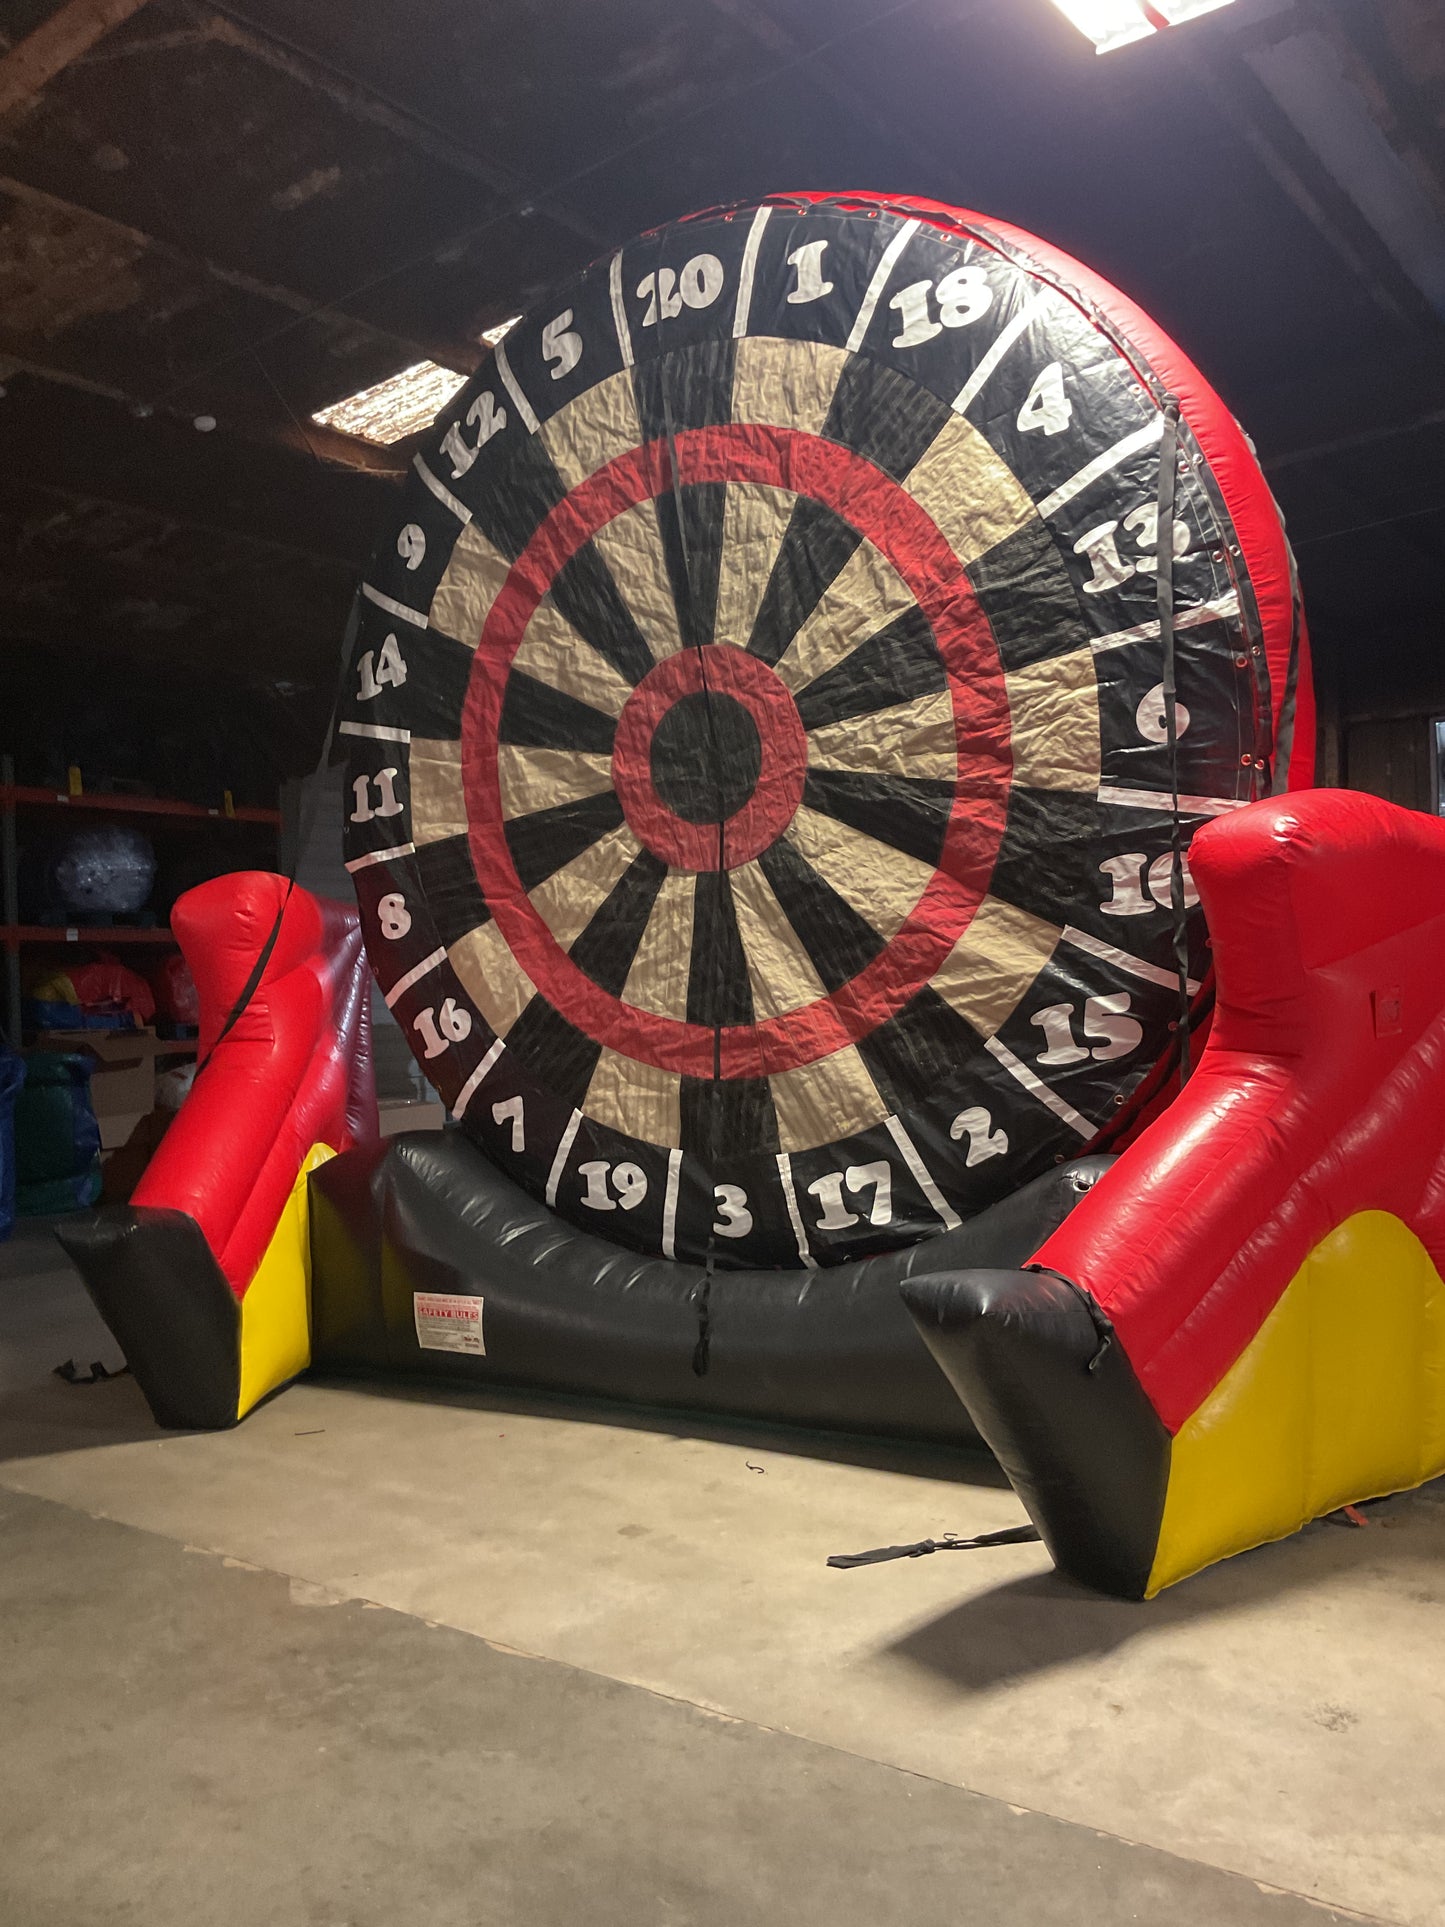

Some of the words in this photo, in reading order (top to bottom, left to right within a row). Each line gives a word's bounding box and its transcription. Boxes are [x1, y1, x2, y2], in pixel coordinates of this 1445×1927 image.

[636, 253, 724, 327] 20
[787, 239, 834, 304] 1
[889, 265, 994, 349] 18
[542, 308, 583, 380] 5
[1016, 361, 1073, 436] 4
[439, 391, 507, 480] 12
[397, 523, 427, 571] 9
[356, 633, 408, 700] 14
[350, 767, 404, 823] 11
[377, 892, 412, 940] 8
[413, 997, 472, 1059] 16
[1030, 991, 1143, 1065] 15
[491, 1095, 525, 1153] 7
[949, 1106, 1009, 1168] 2
[578, 1160, 648, 1211] 19
[713, 1184, 753, 1238] 3
[807, 1160, 892, 1230] 17
[418, 1307, 450, 1318] SAFETY
[451, 1310, 479, 1320] RULES
